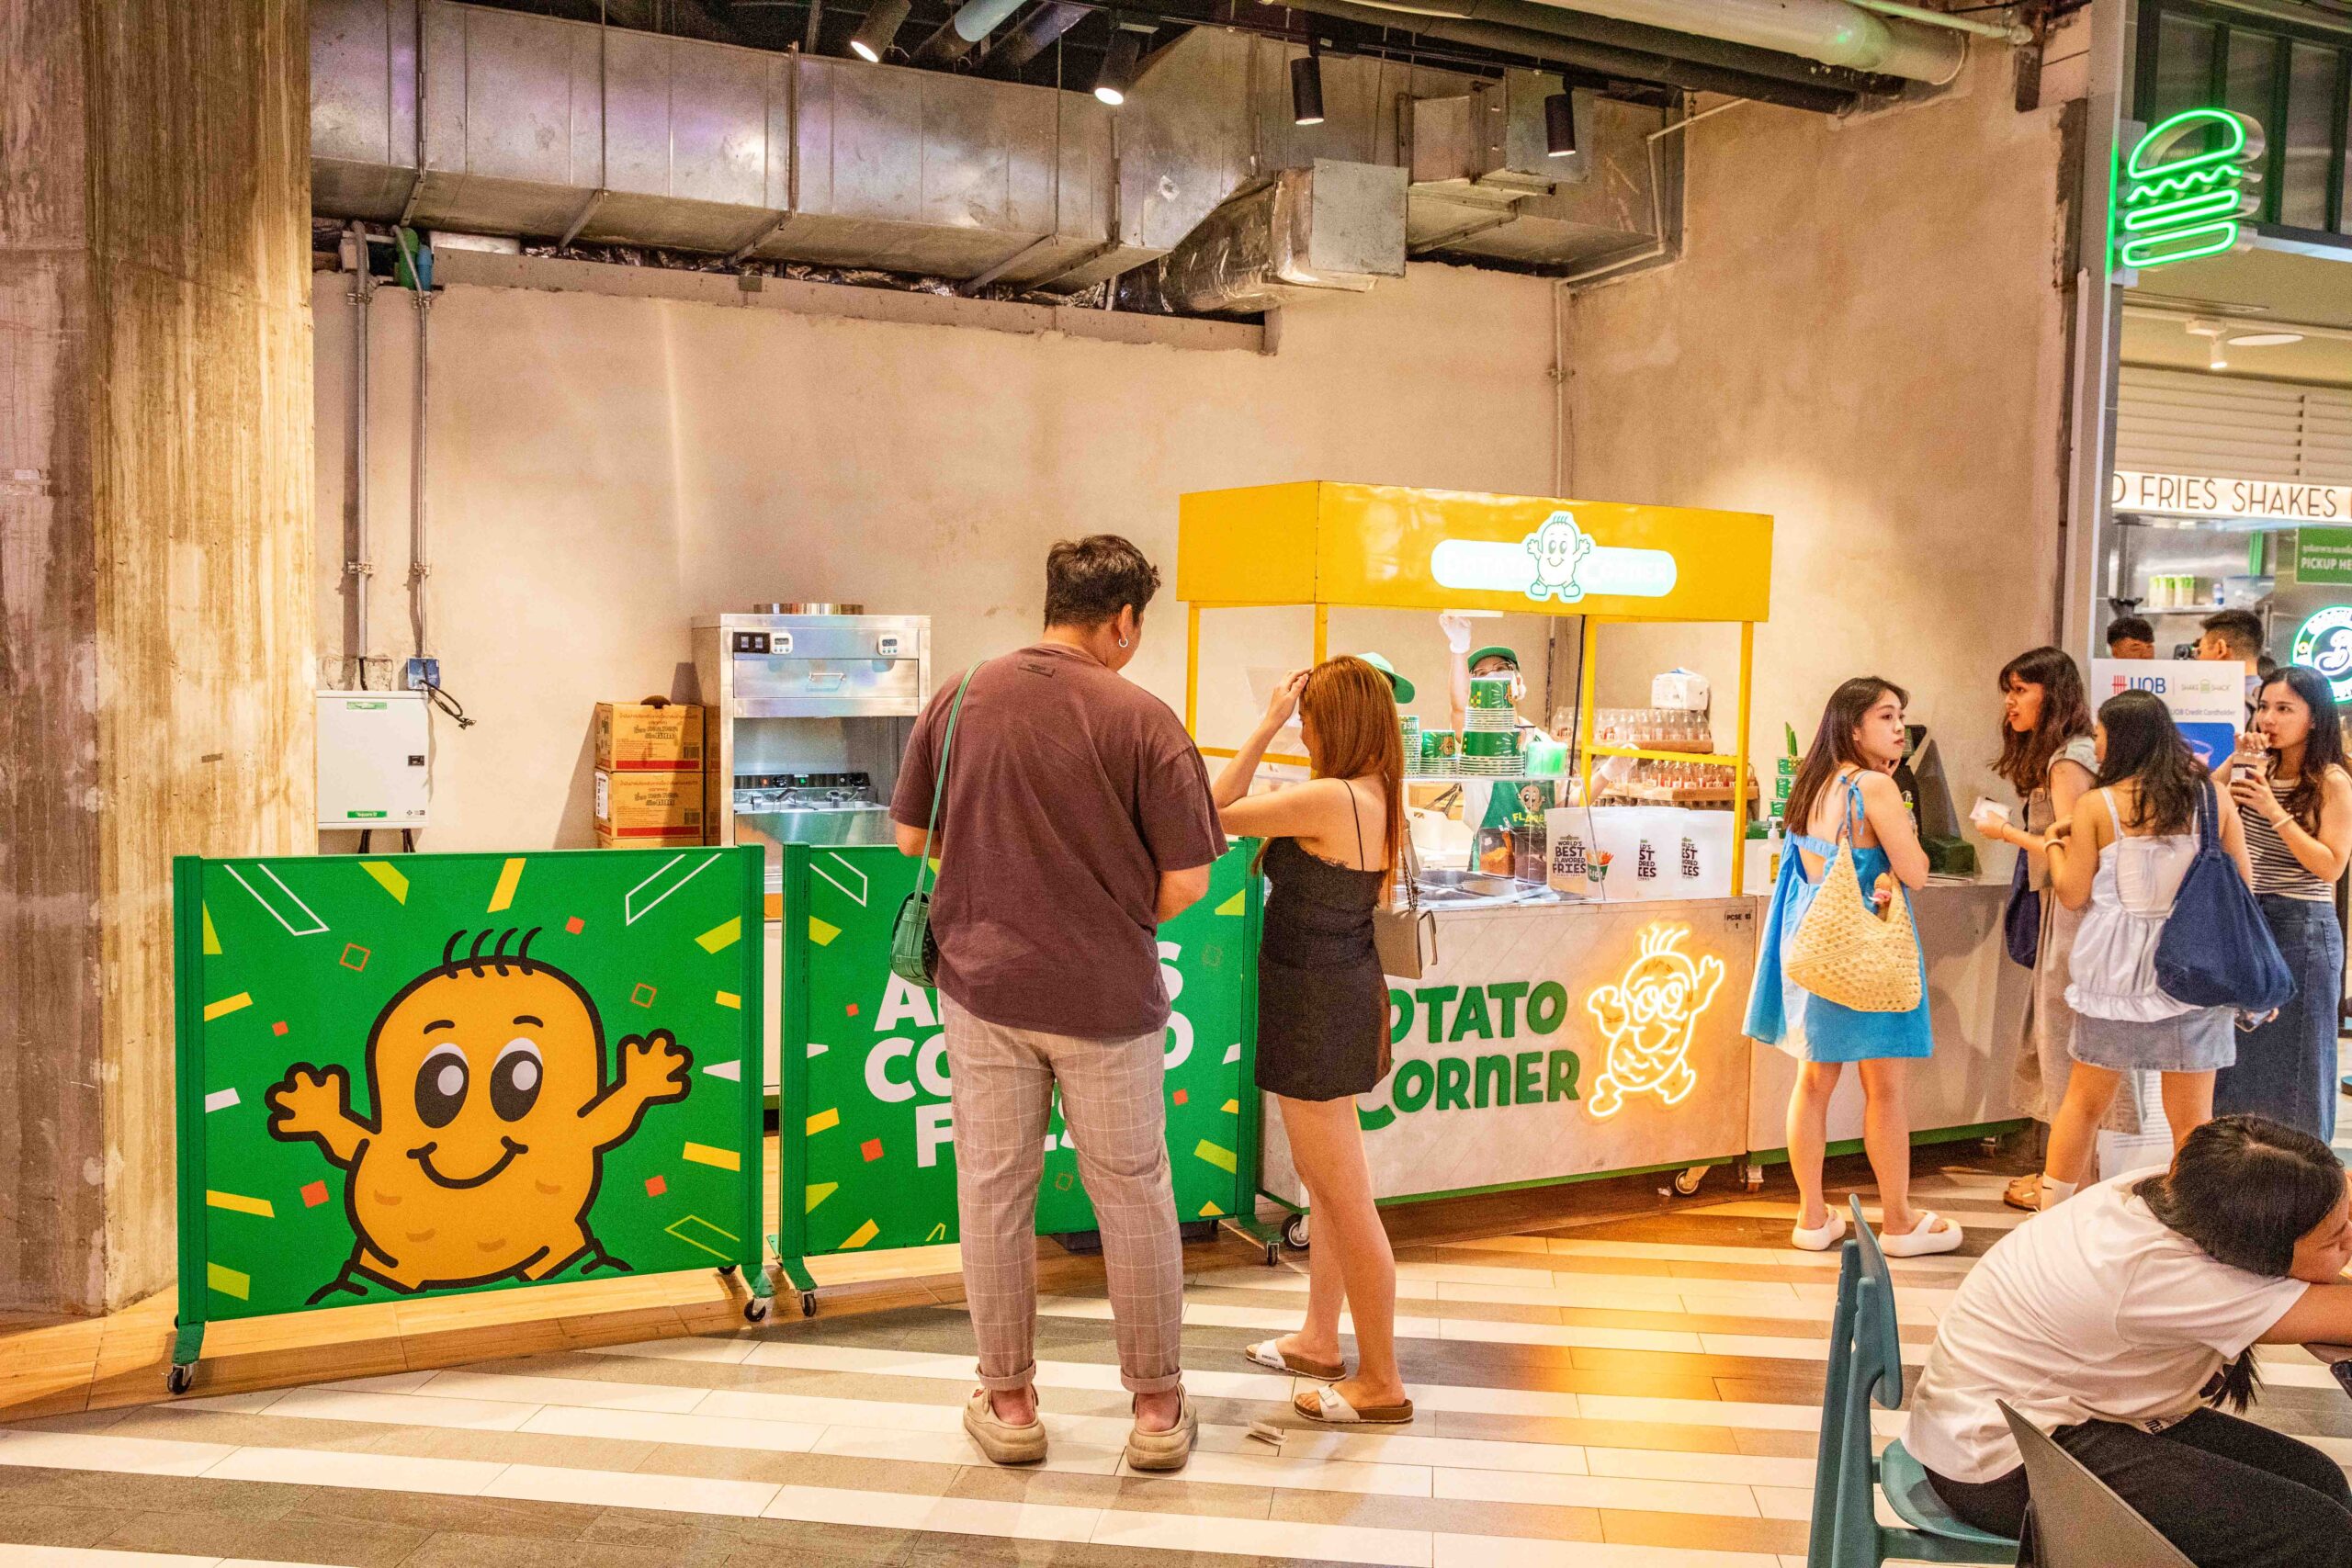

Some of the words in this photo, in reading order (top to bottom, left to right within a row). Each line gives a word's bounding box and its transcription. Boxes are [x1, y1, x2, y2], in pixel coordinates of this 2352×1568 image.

[2140, 475, 2218, 511] FRIES
[2233, 481, 2337, 518] SHAKES
[2301, 557, 2338, 570] PICKUP
[2338, 558, 2352, 571] HE
[2130, 676, 2166, 694] UOB
[1555, 846, 1586, 858] BEST
[1639, 850, 1656, 861] ST
[1681, 848, 1699, 860] EST
[1552, 863, 1587, 874] FRIES
[1389, 980, 1568, 1044] OTATO
